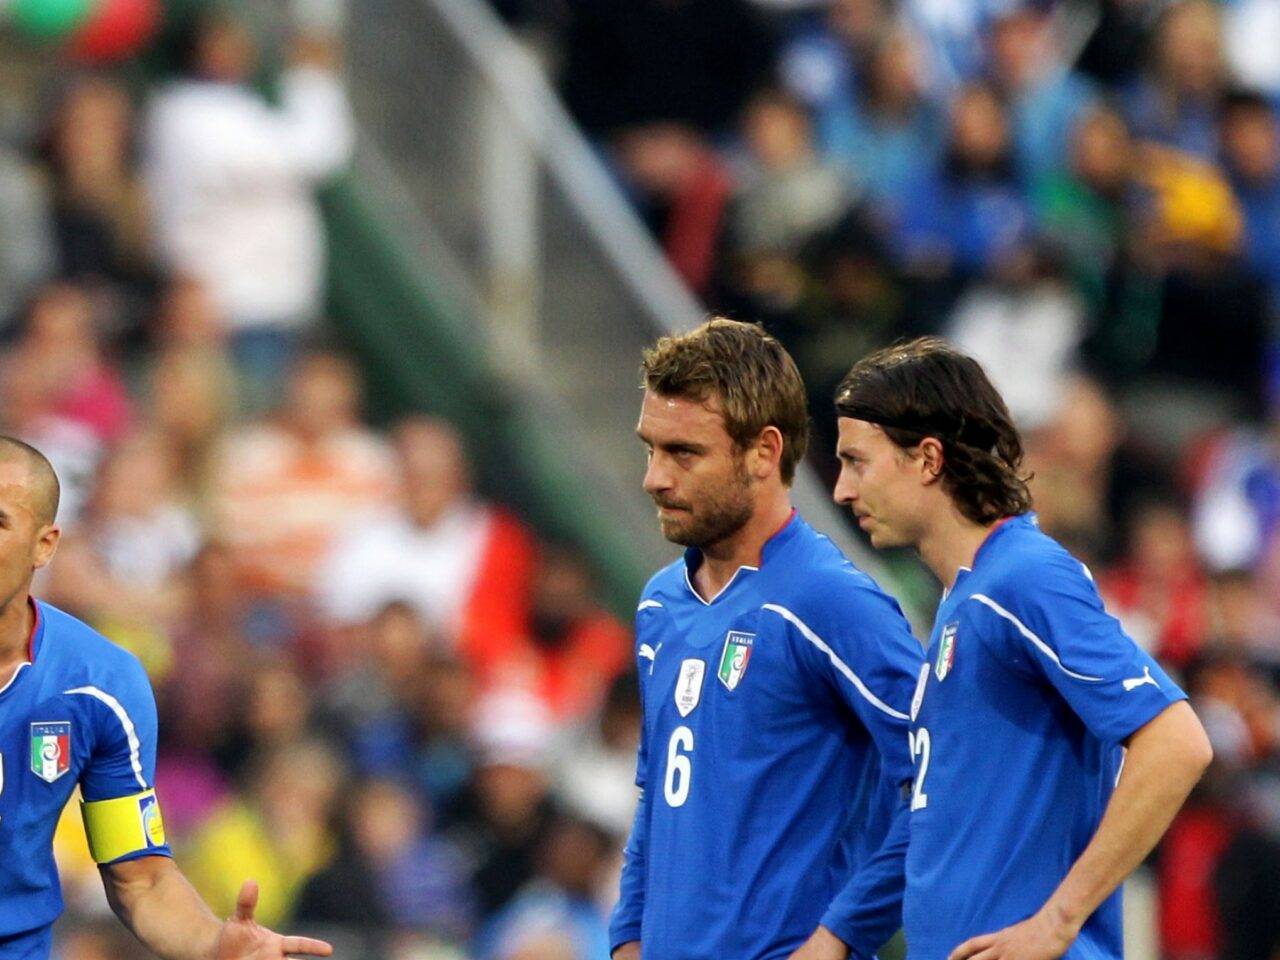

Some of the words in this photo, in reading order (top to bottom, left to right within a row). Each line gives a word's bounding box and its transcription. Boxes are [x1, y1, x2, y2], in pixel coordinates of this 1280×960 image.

[35, 726, 65, 735] ITALIA
[663, 725, 694, 807] 6
[908, 726, 932, 812] 2
